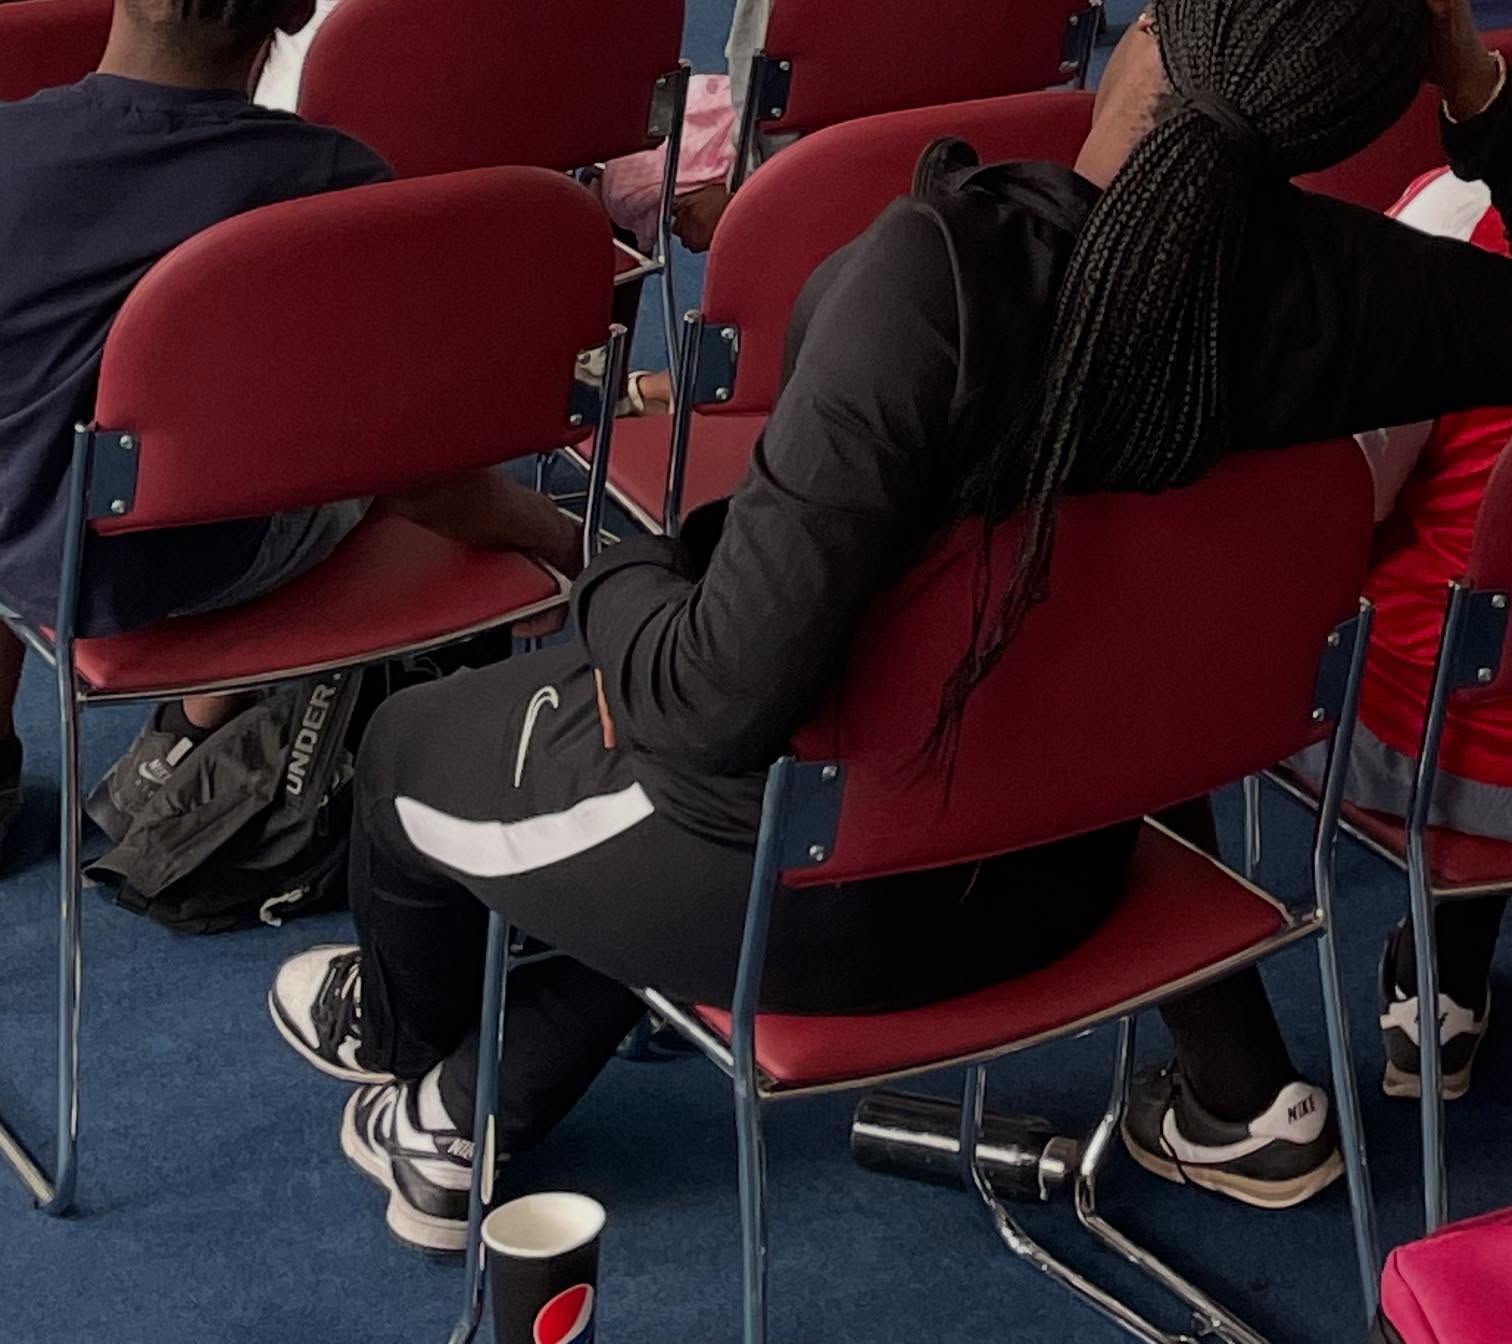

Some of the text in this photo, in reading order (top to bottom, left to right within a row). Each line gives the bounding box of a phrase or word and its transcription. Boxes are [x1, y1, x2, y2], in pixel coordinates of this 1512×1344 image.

[286, 683, 337, 796] UNDER
[1287, 1093, 1315, 1125] NIKE
[447, 1137, 476, 1160] NIK
